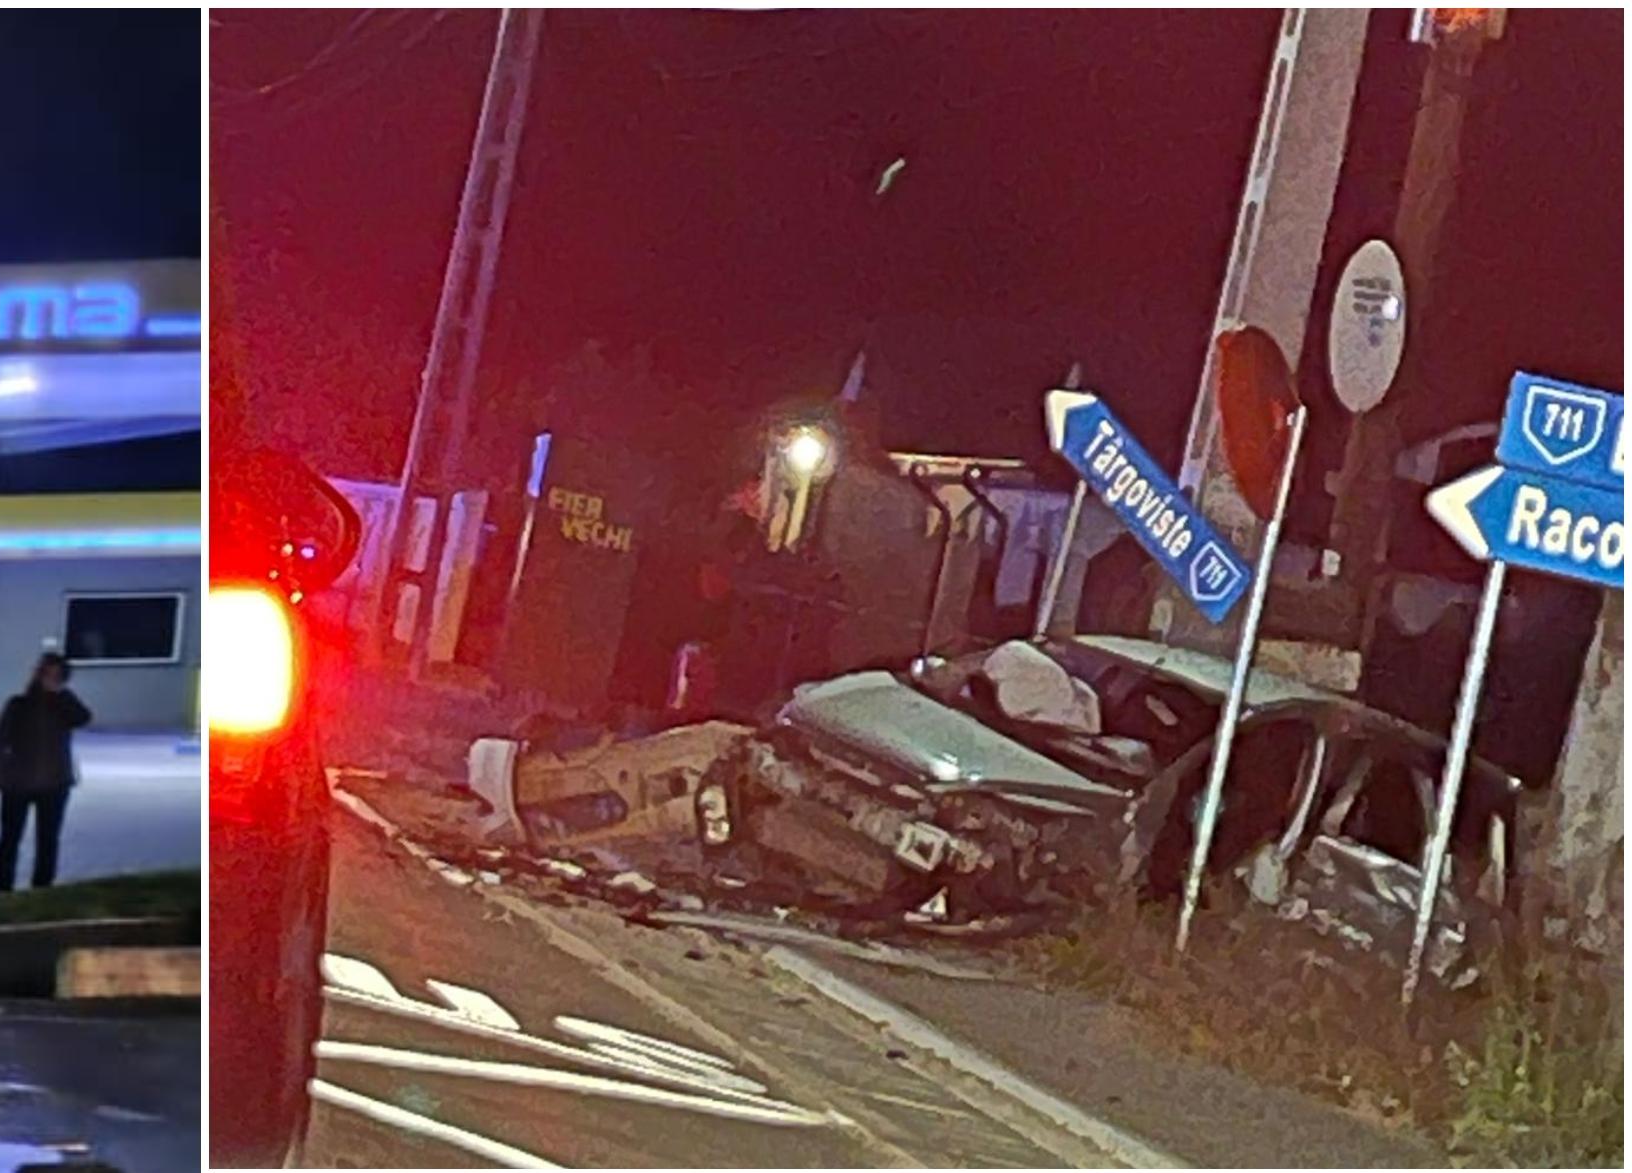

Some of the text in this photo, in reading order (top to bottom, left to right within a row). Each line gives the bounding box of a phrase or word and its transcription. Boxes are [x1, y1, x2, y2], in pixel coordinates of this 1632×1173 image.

[1542, 403, 1585, 442] 711
[549, 486, 603, 519] FIER
[561, 515, 633, 552] VECHI
[1505, 484, 1625, 569] Raco
[1199, 555, 1228, 590] 711
